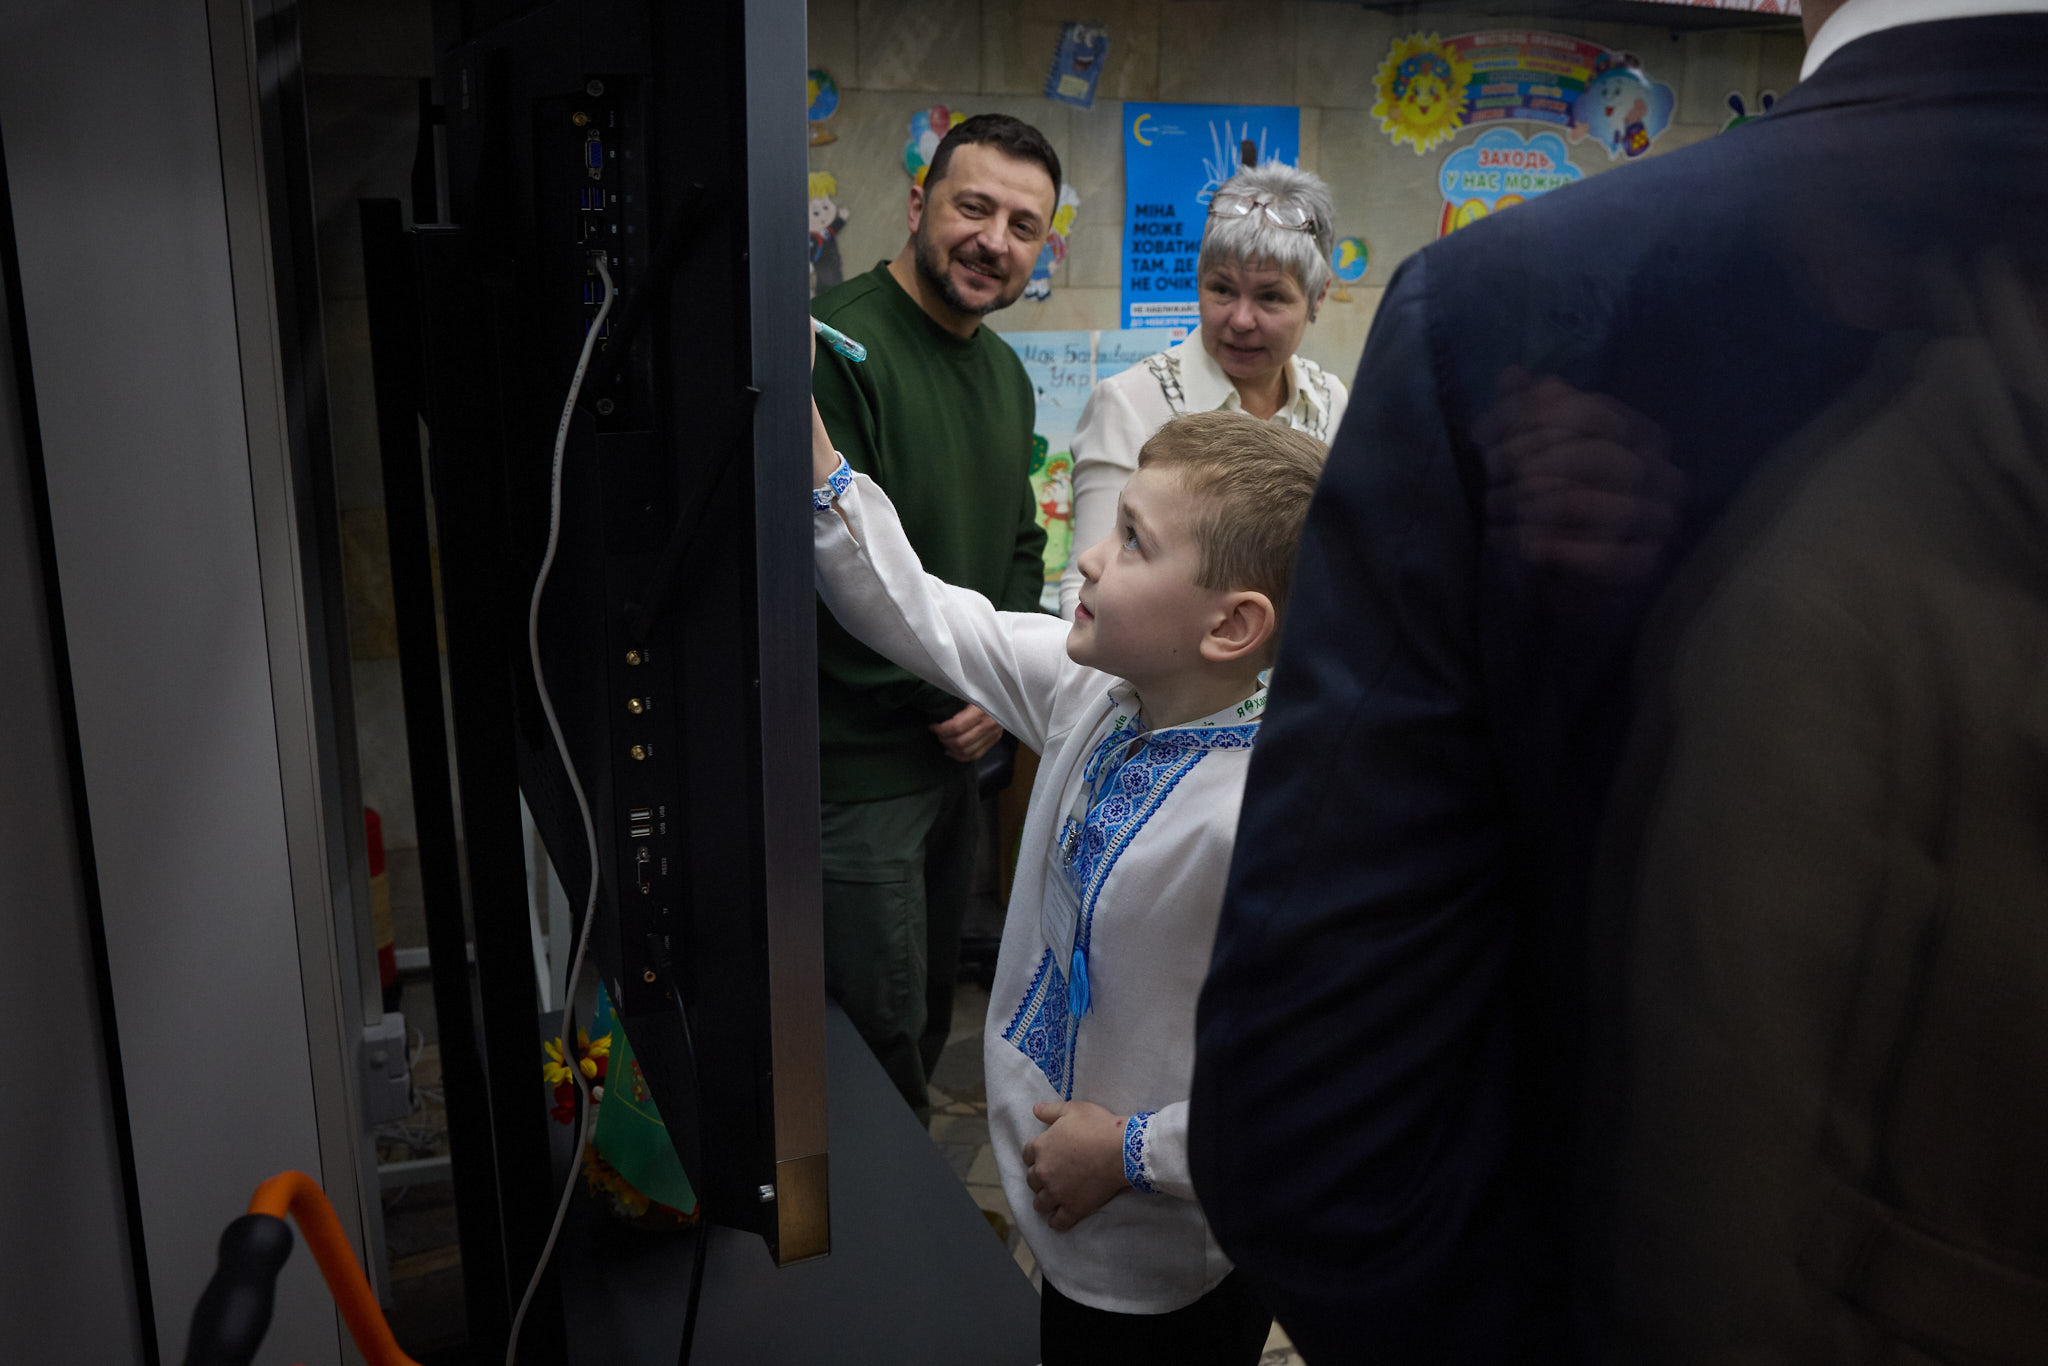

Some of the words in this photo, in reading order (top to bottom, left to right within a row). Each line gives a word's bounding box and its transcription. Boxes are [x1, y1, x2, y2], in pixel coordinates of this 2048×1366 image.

[1479, 149, 1555, 171] ЗАХОДЬ,
[1446, 172, 1459, 190] У
[1462, 172, 1501, 191] НАС
[1134, 203, 1176, 218] МІНА
[1133, 221, 1184, 237] МОЖЕ
[1131, 257, 1169, 274] ТАМ,
[1173, 258, 1194, 275] ДЕ
[1131, 277, 1150, 291] НЕ
